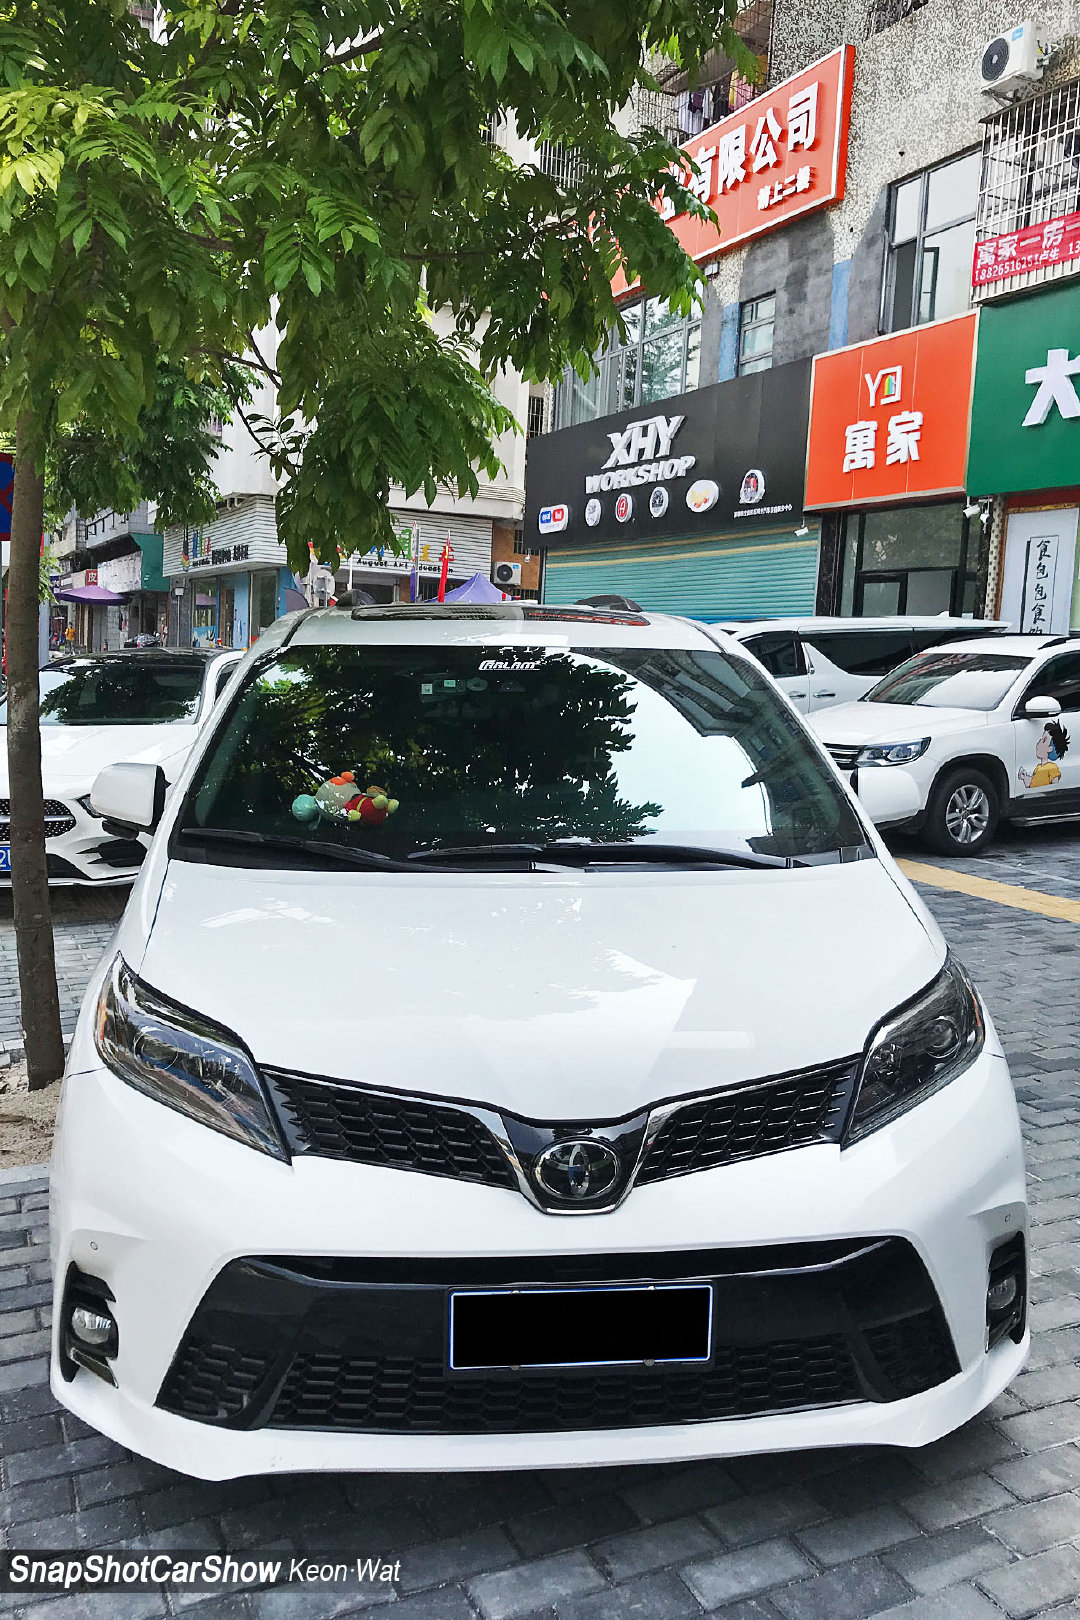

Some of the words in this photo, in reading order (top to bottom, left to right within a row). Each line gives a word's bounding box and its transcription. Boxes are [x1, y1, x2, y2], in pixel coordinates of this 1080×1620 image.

[1021, 348, 1080, 426] 大
[601, 415, 686, 470] XHY
[843, 411, 924, 473] 寓家
[585, 455, 696, 494] WORKSHOP
[417, 563, 454, 574] ducatn
